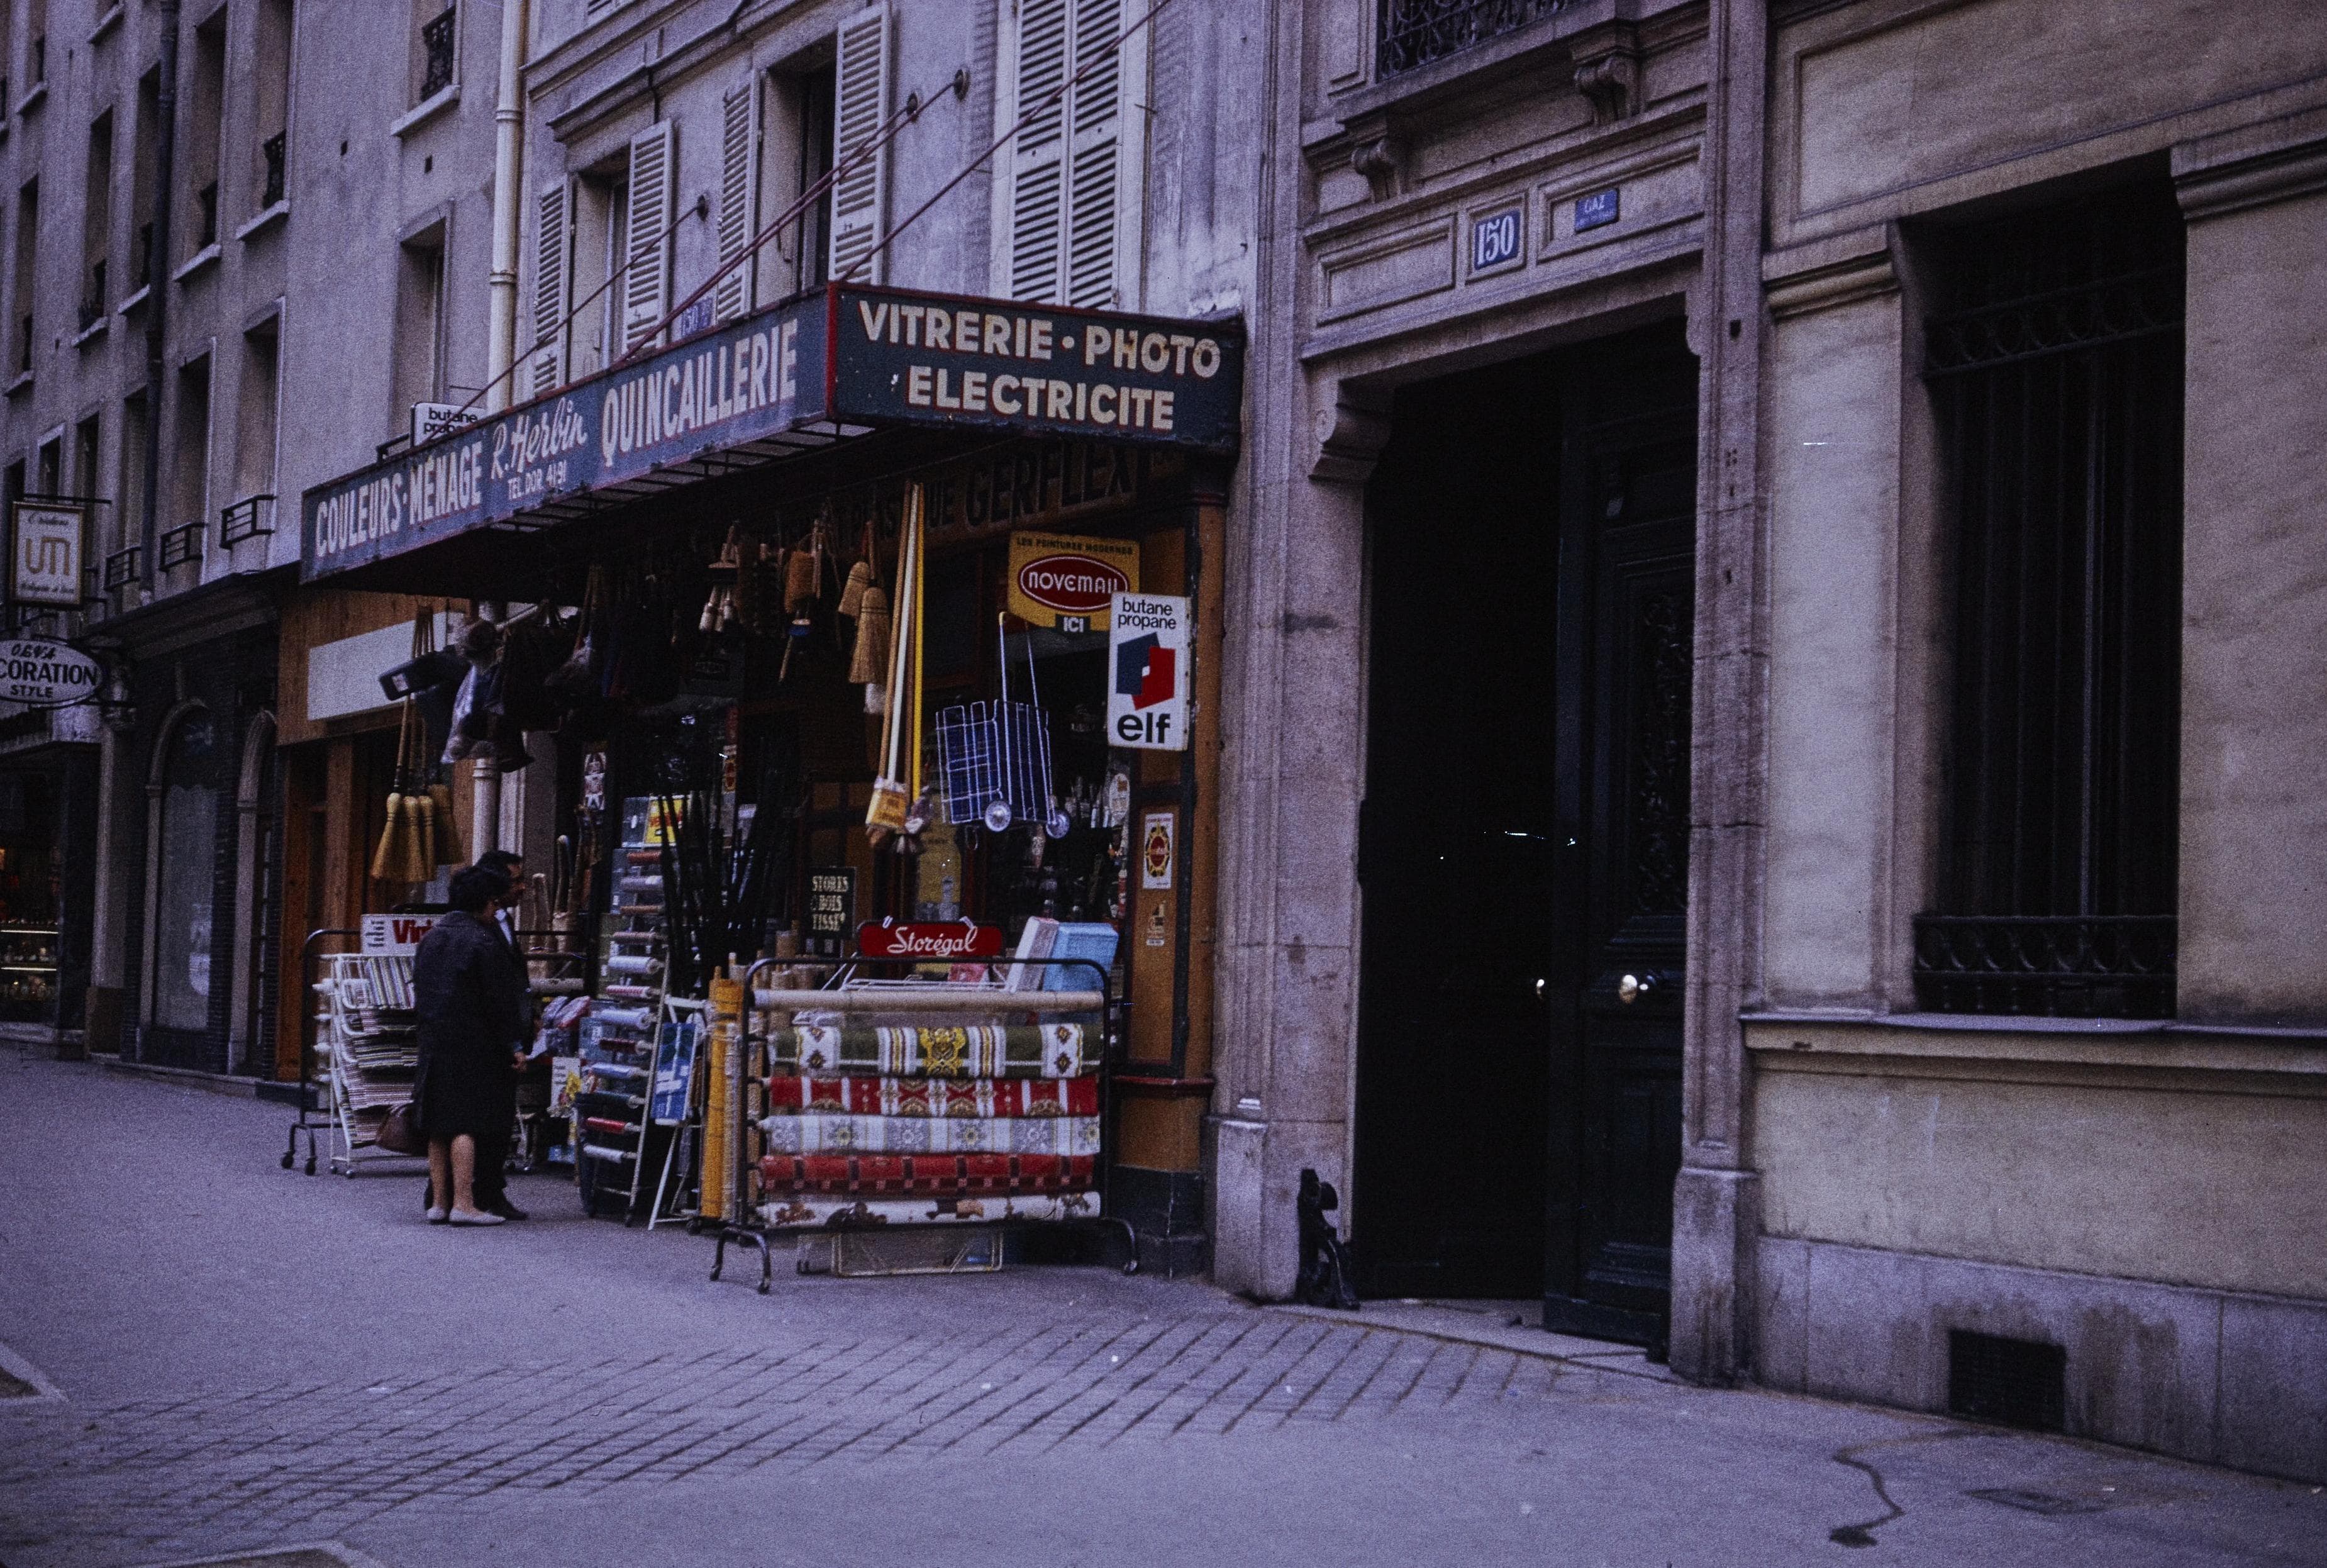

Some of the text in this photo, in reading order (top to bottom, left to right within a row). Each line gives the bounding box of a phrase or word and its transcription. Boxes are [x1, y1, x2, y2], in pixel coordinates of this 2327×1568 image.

[1477, 215, 1515, 265] 150
[858, 299, 1221, 379] VITRERIE PHOTO
[907, 365, 1175, 432] ELECTRICITE
[428, 406, 478, 423] butane
[316, 472, 403, 558] COULEURS
[511, 396, 589, 474] Herbin
[601, 317, 799, 468] QUINCAILLERIE
[423, 422, 464, 435] prop
[1122, 596, 1173, 615] butane
[1062, 616, 1084, 633] ICI
[1118, 614, 1177, 630] propane
[10, 685, 53, 698] STYLE
[1117, 712, 1171, 743] elf
[811, 875, 850, 892] STORES
[887, 925, 979, 957] Storégal
